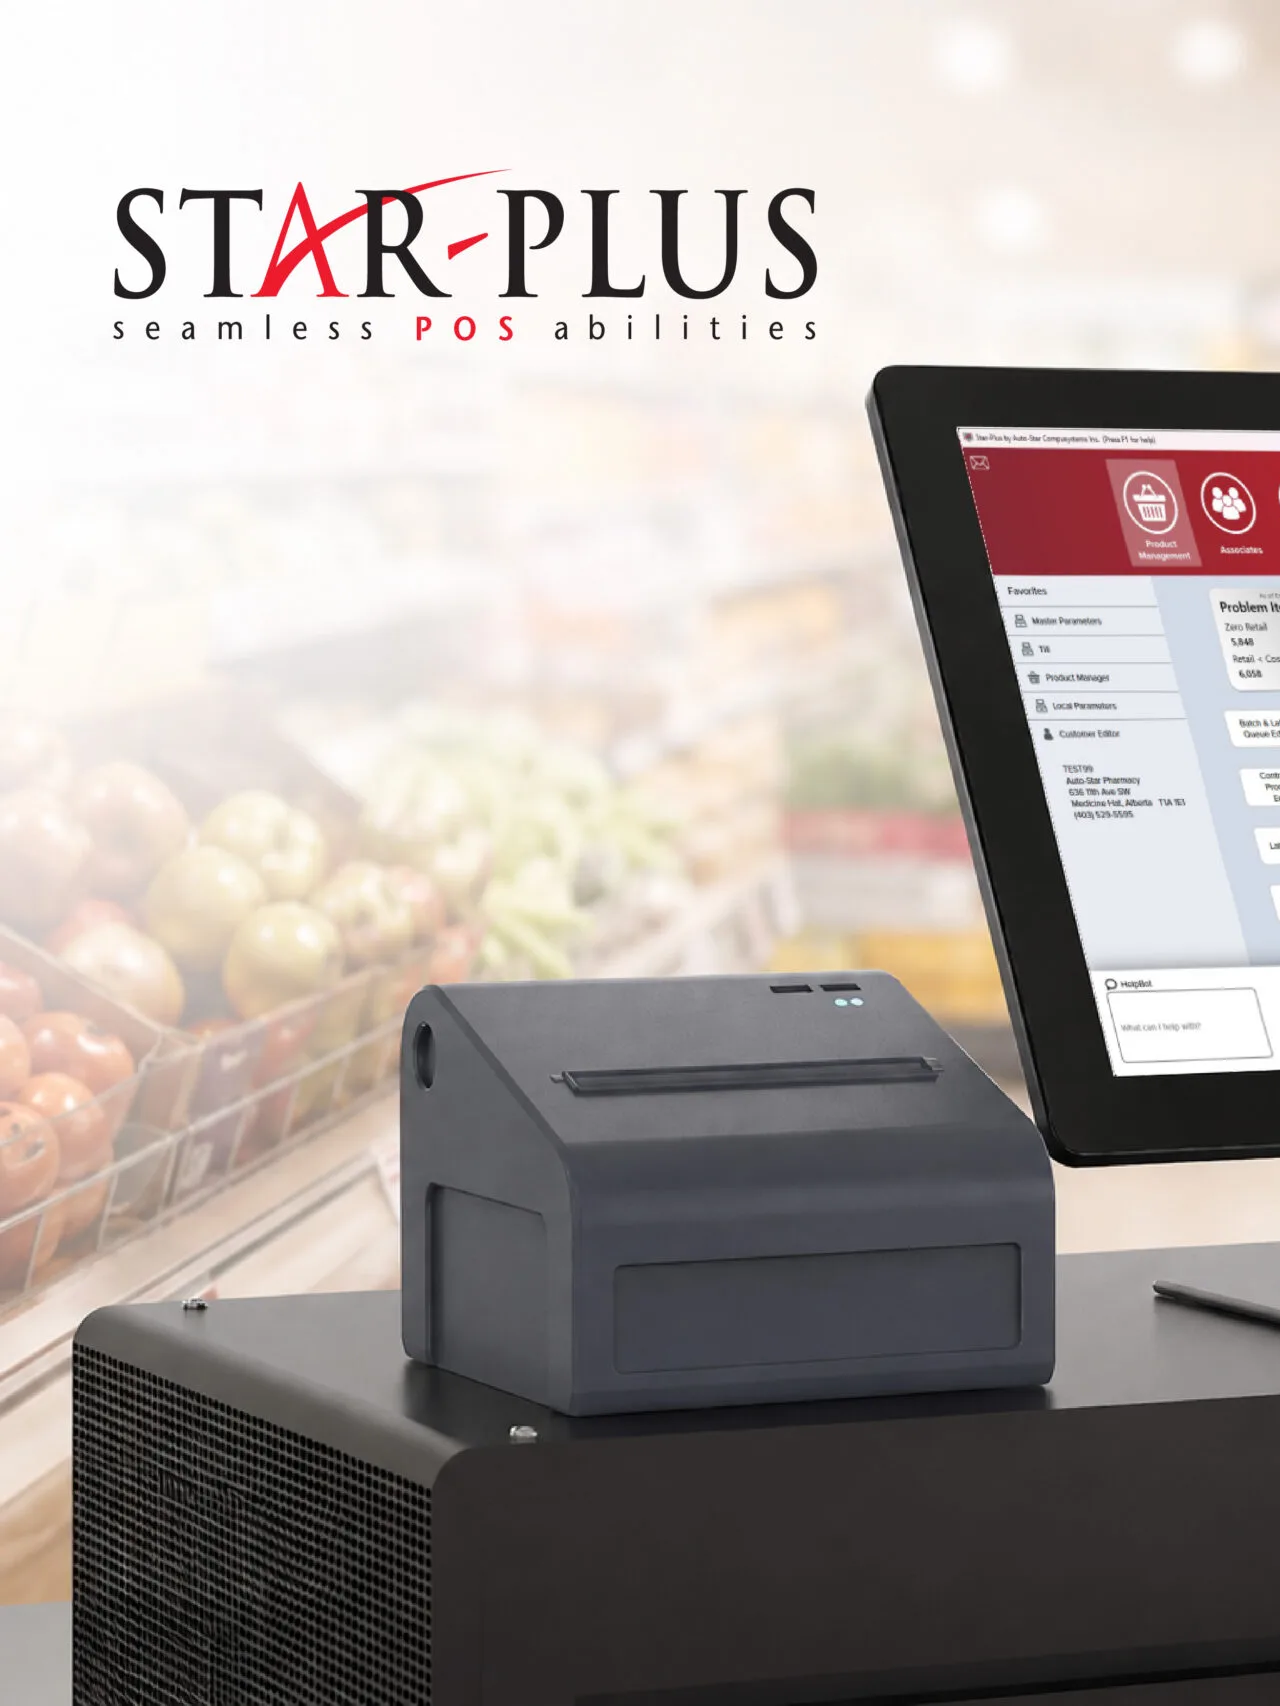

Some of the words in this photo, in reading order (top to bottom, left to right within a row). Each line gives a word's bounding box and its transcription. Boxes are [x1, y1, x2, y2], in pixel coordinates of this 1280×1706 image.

[1145, 539, 1177, 548] Product
[1220, 545, 1263, 555] Associates
[1139, 551, 1190, 562] Management
[1007, 586, 1047, 596] Favorites
[1220, 601, 1268, 613] Problem
[1031, 617, 1057, 625] Master
[1059, 617, 1102, 626] Parameters
[1225, 623, 1243, 632] Zero
[1245, 623, 1267, 632] Retail
[1231, 637, 1254, 647] 5,848
[1233, 654, 1255, 663] Retail
[1046, 674, 1075, 682] Product
[1077, 674, 1110, 683] Manager
[1052, 702, 1073, 710] Local
[1074, 702, 1117, 710] Parameters
[1239, 719, 1261, 728] Batch
[1059, 730, 1096, 738] Customer
[1098, 730, 1120, 738] Editor
[1243, 730, 1268, 739] Queue
[1103, 776, 1140, 786] Pharmacy
